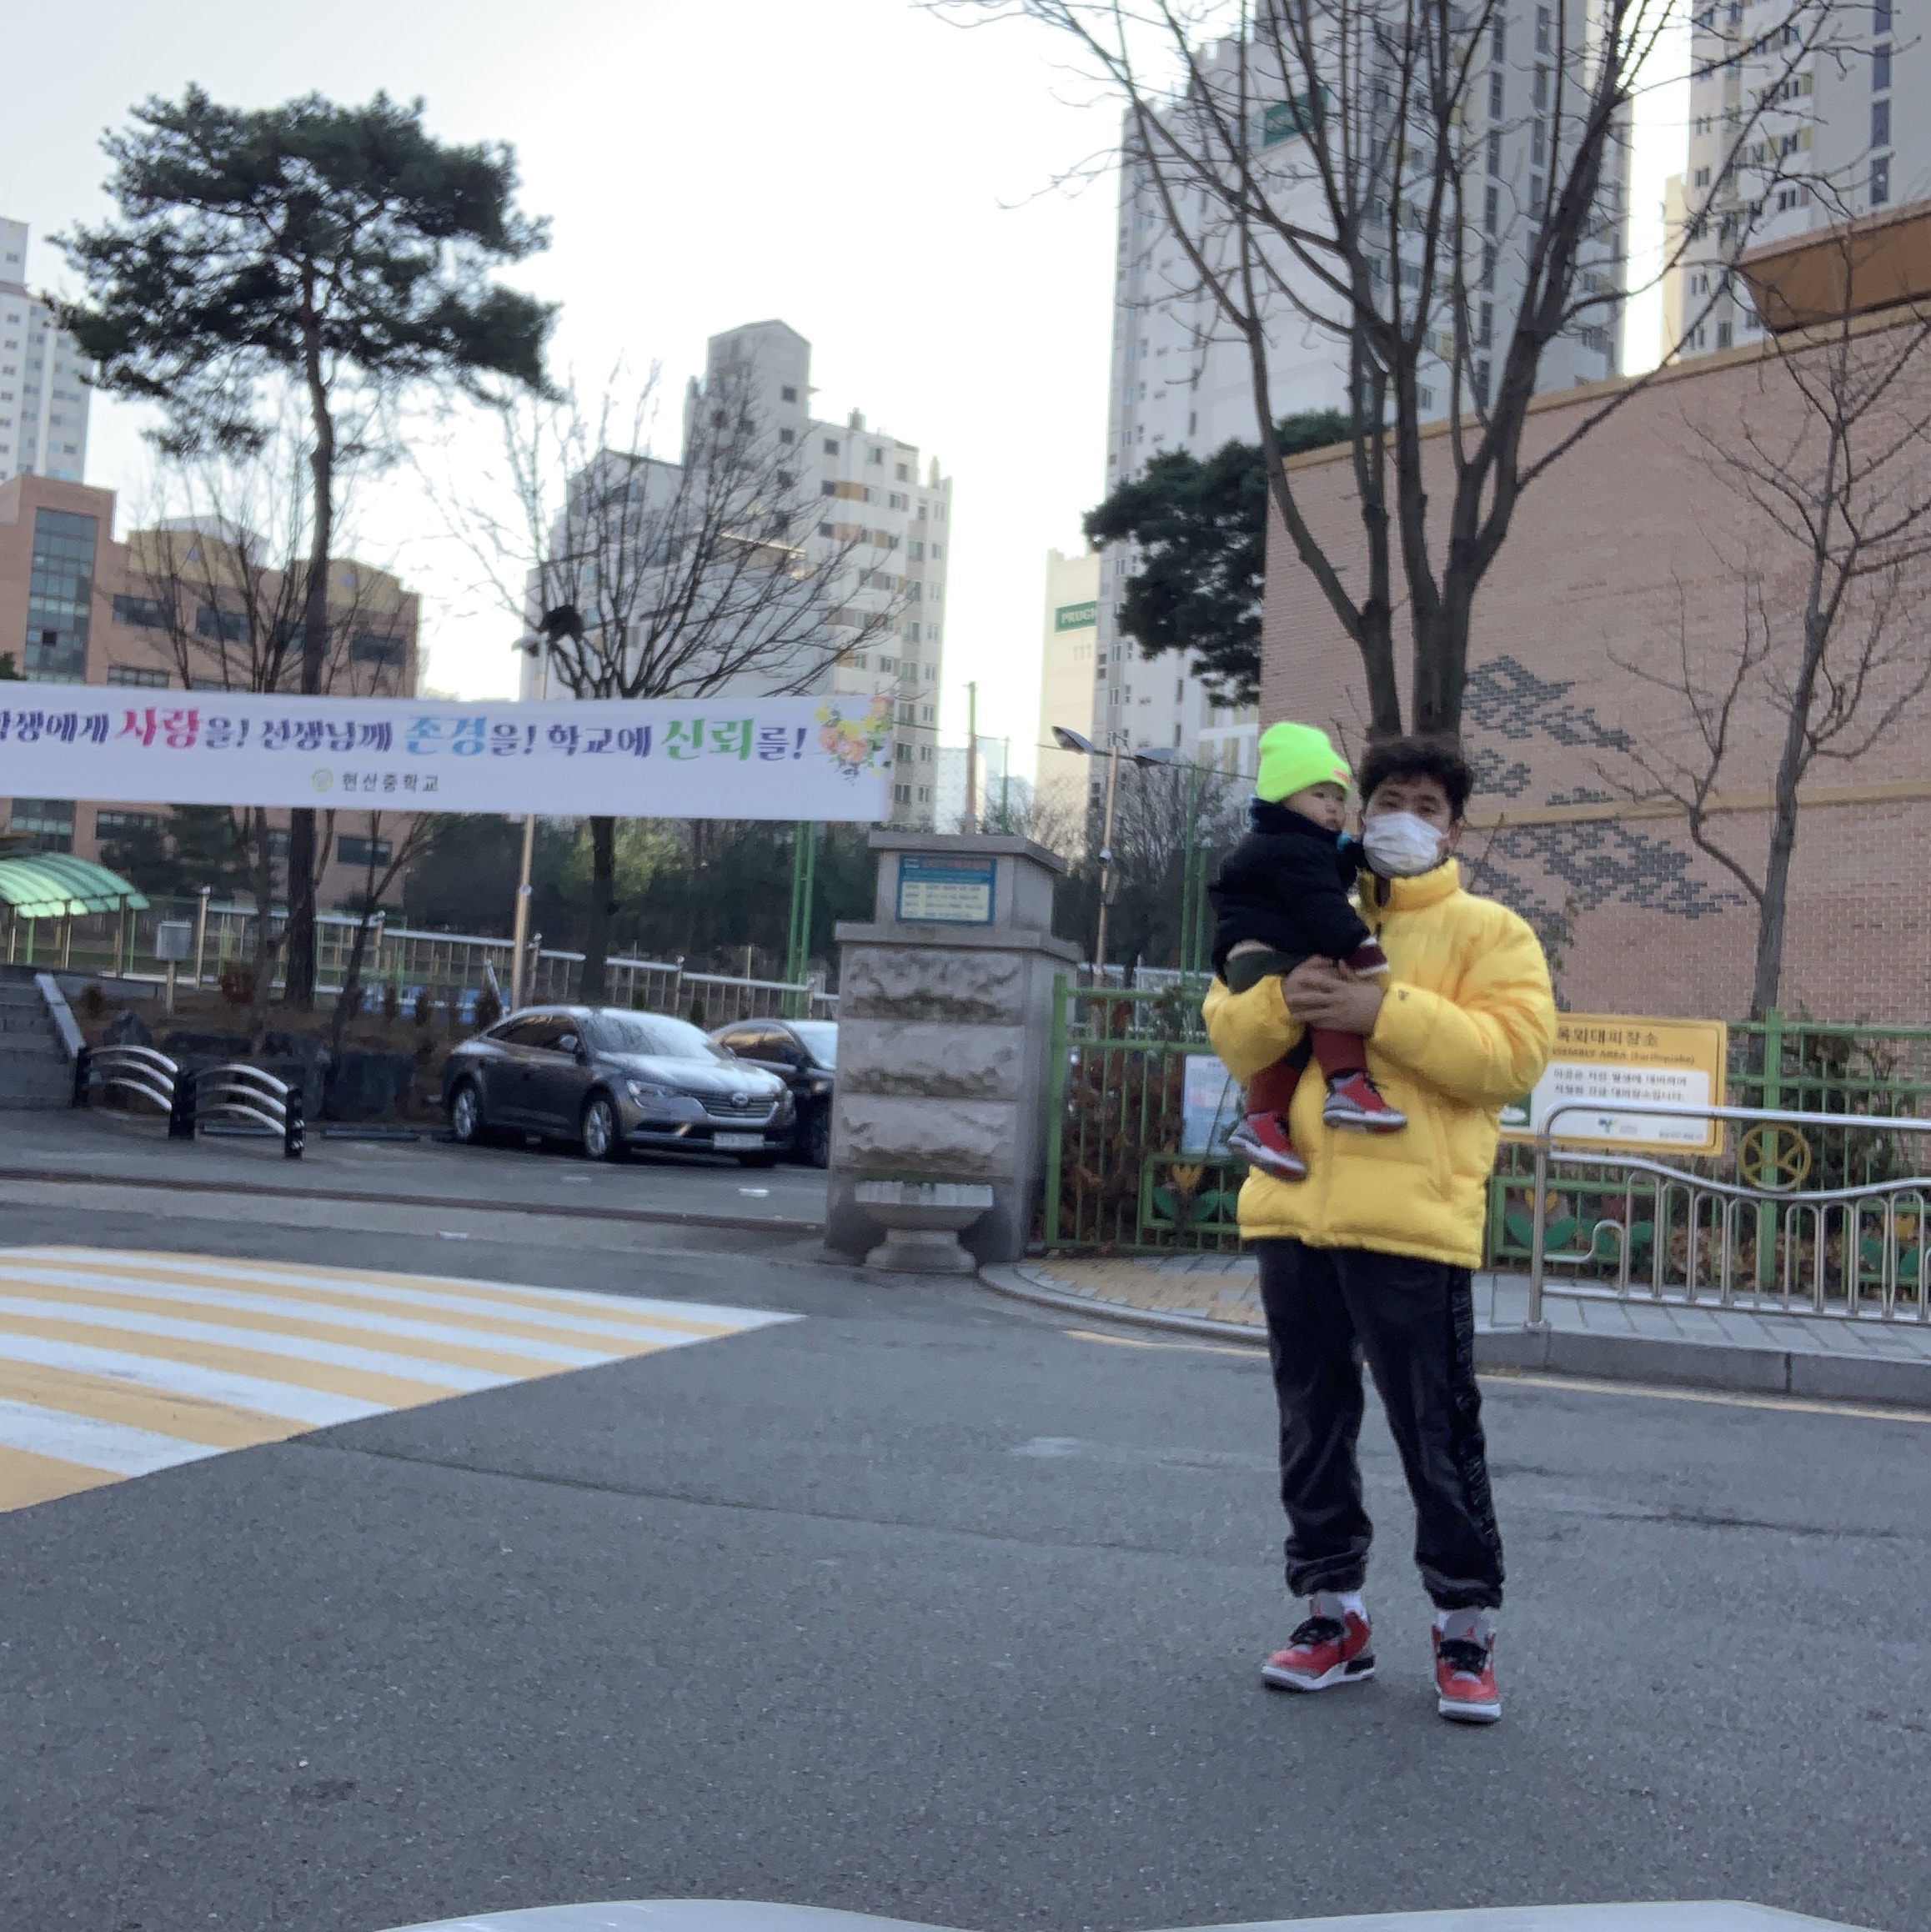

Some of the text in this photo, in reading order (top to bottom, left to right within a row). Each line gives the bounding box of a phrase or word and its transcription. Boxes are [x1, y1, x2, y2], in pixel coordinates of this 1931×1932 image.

[115, 706, 249, 749] 사랑을!
[259, 719, 394, 752] 선생님께
[405, 716, 536, 756] 존경을!
[547, 723, 652, 757] 학교에
[661, 718, 807, 760] 신뢰를!
[343, 772, 439, 793] 현산중학교
[1552, 1047, 1596, 1059] SSEMBLY
